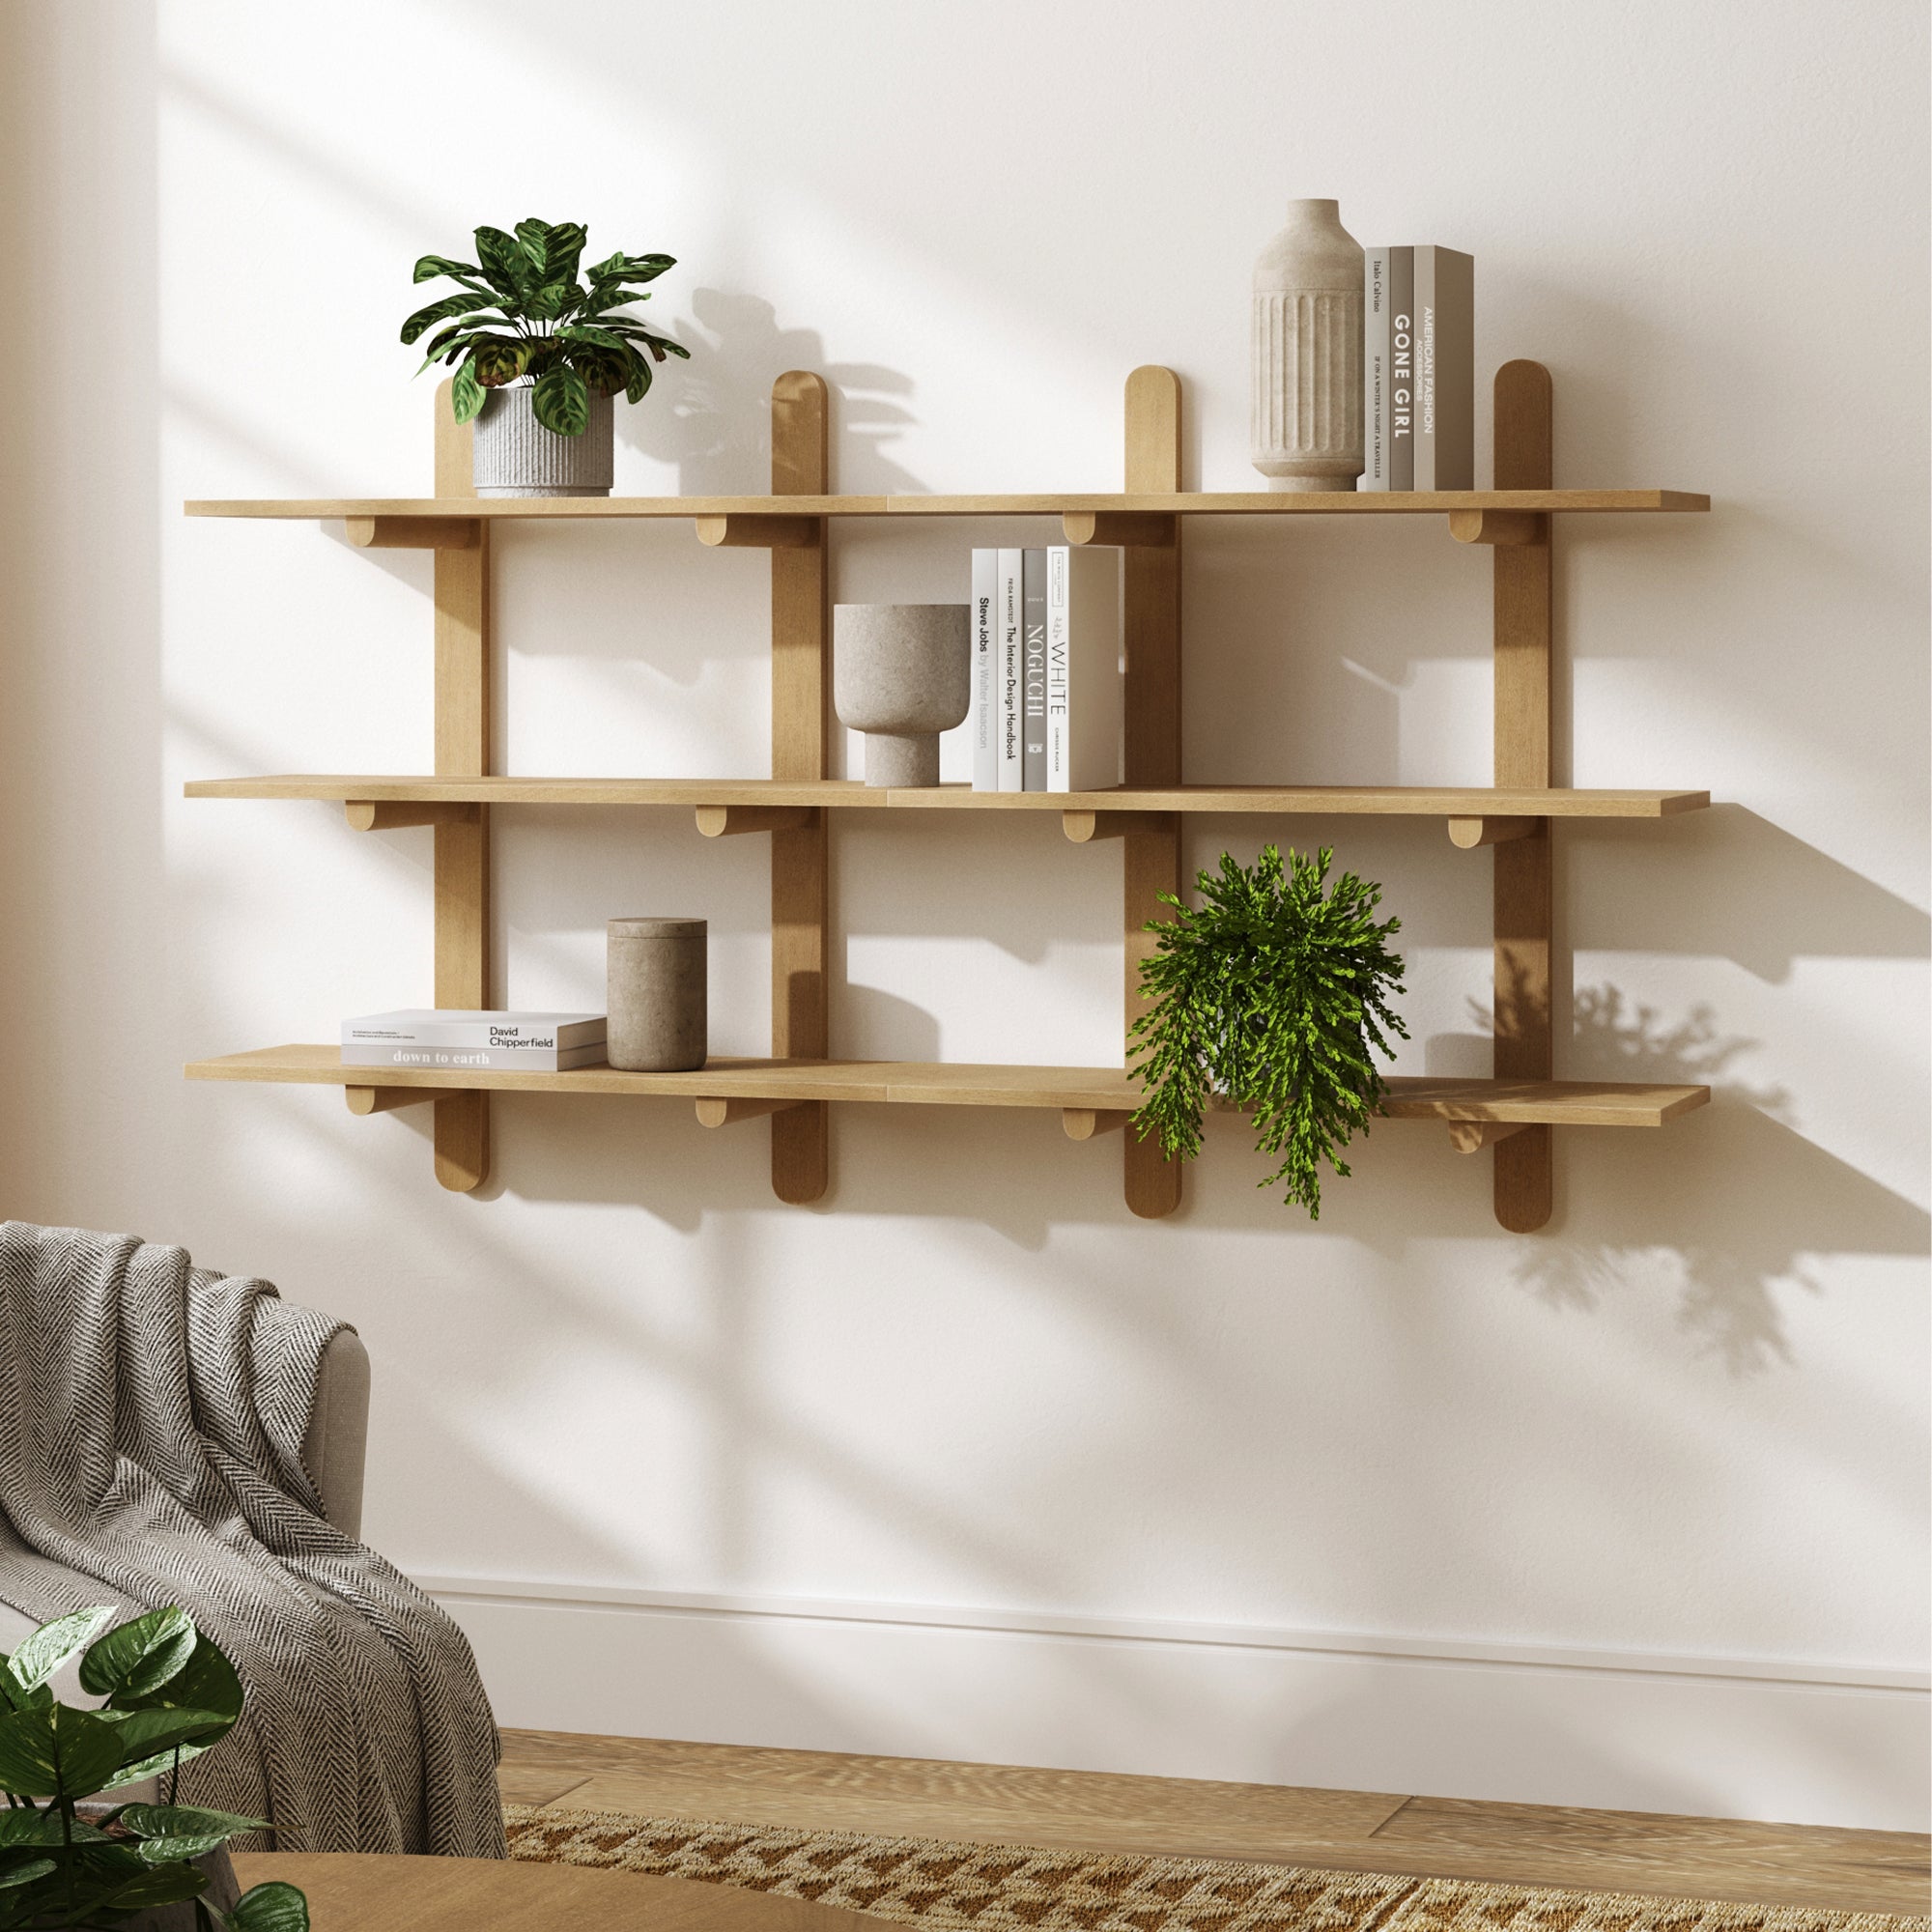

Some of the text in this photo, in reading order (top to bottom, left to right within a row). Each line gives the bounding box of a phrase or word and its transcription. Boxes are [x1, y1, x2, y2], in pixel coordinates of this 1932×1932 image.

[1373, 260, 1382, 313] Italo Calvino
[1375, 363, 1380, 374] ON
[1394, 314, 1410, 438] GONE GIRL
[1423, 306, 1434, 434] AMERICAN FASHION
[978, 597, 990, 750] Steve Jobs by Walter Isaacson
[1004, 626, 1017, 760] The Interior Design Handbook
[1027, 624, 1044, 717] NOGUCHI
[1050, 641, 1066, 715] WHITE
[393, 1050, 491, 1065] down to earth
[489, 1037, 554, 1049] Chipperfield
[490, 1026, 519, 1037] David
